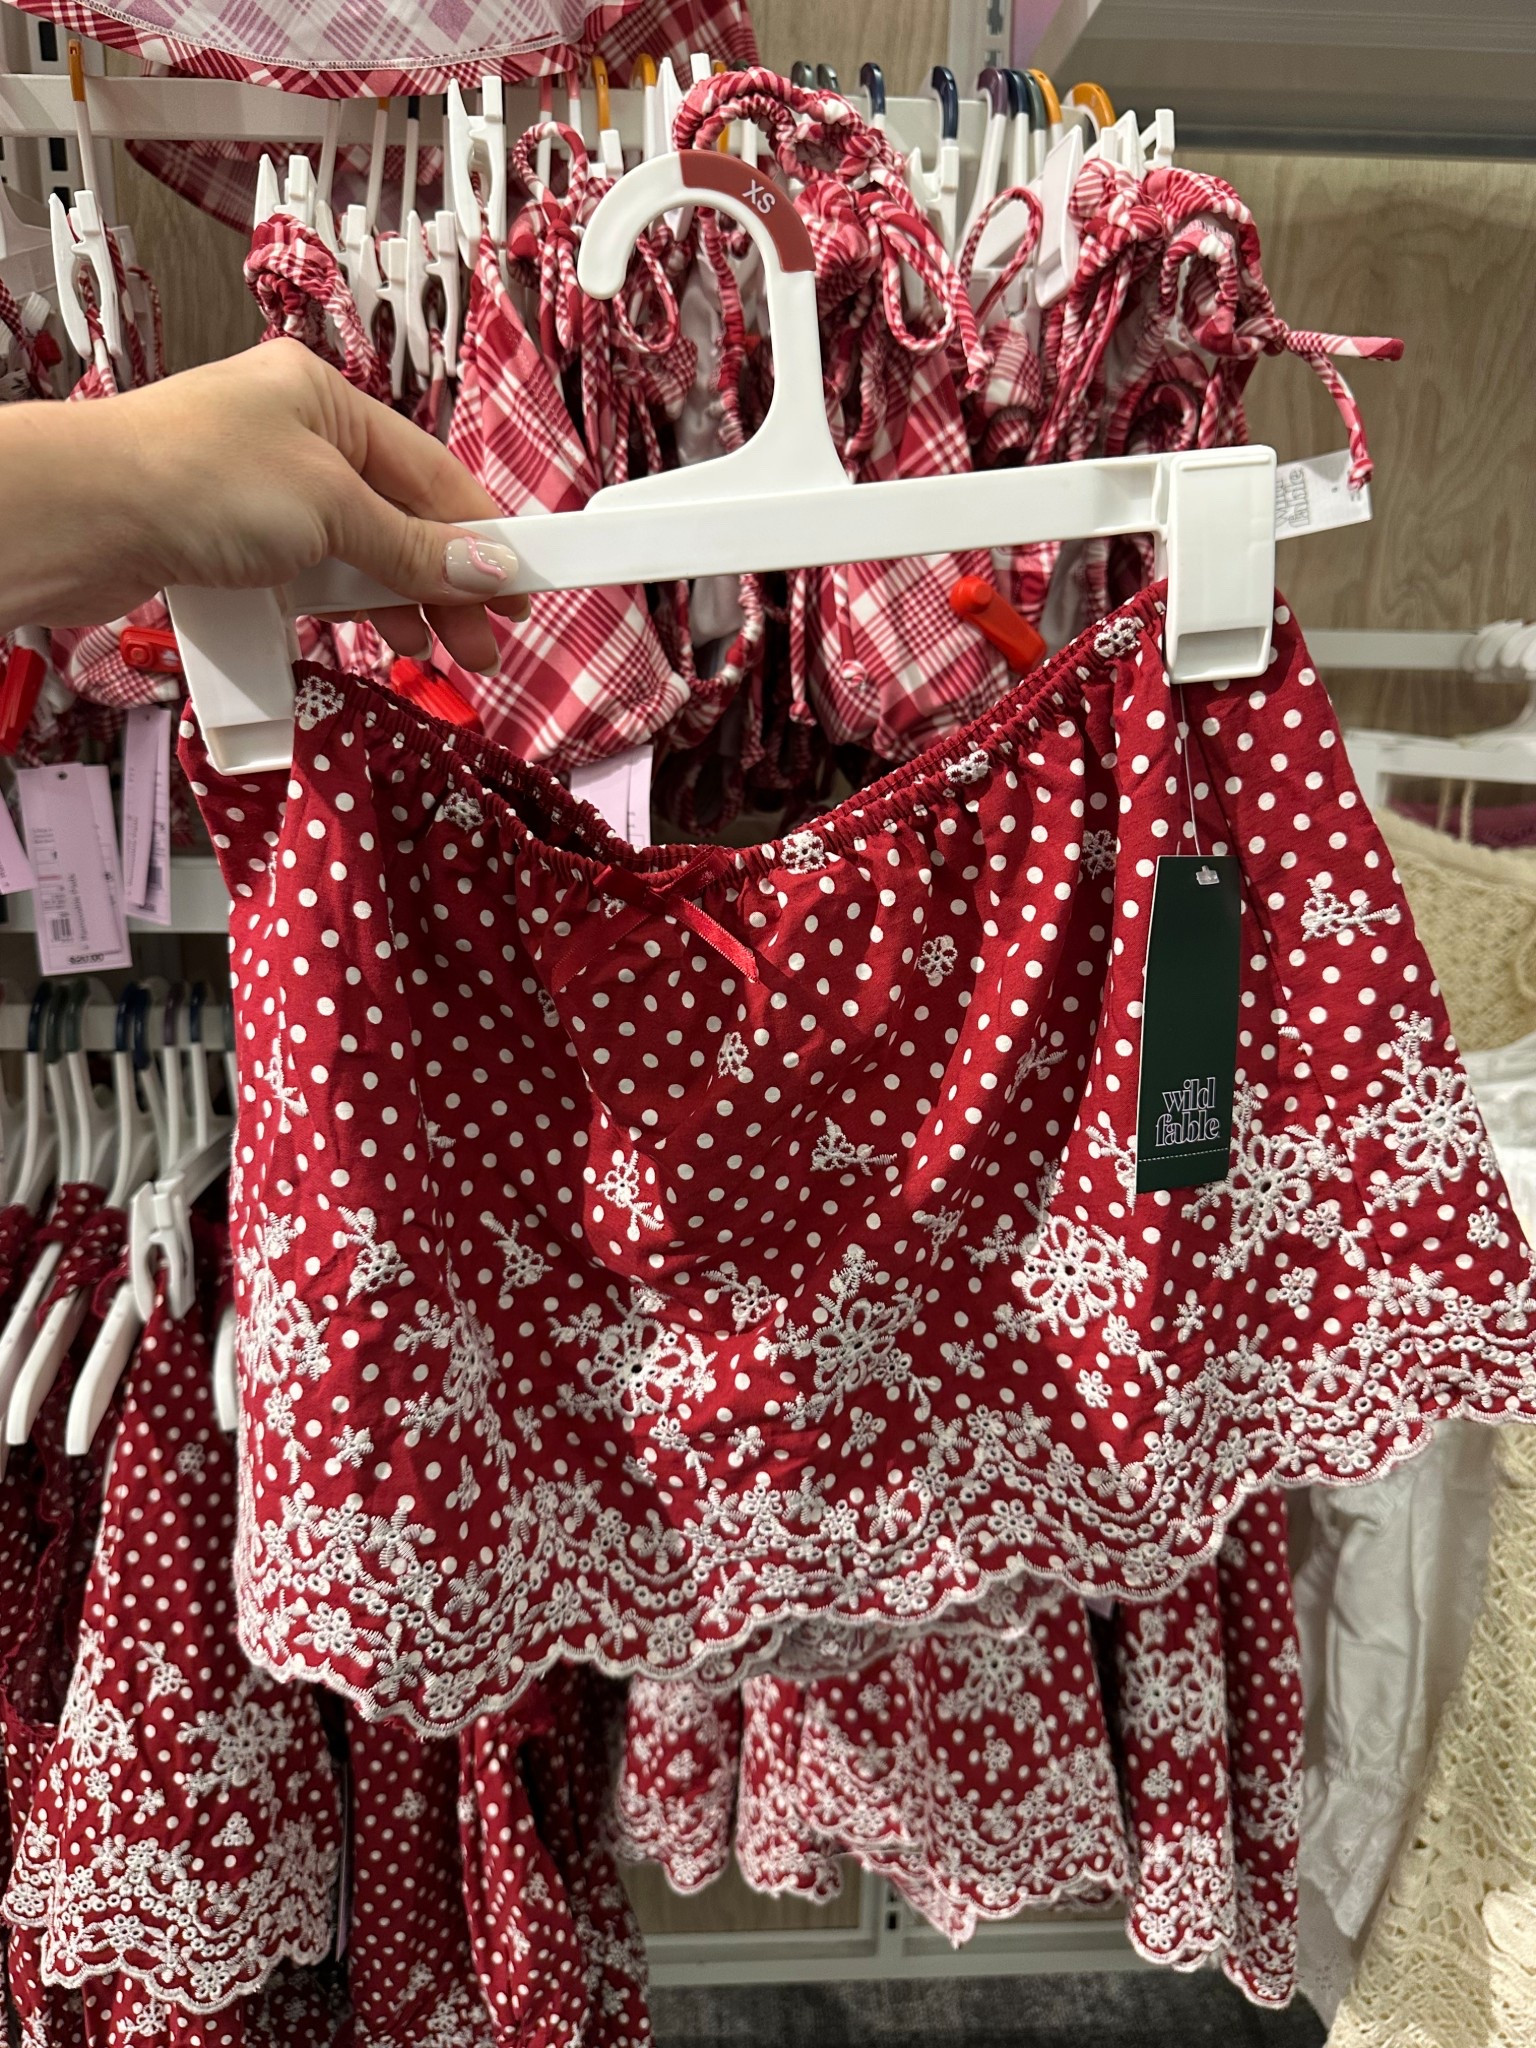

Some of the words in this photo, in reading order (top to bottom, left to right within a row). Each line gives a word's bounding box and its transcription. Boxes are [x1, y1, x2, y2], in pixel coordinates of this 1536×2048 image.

[742, 179, 776, 214] XS
[1162, 1077, 1216, 1112] wild
[1155, 1109, 1220, 1147] fable
